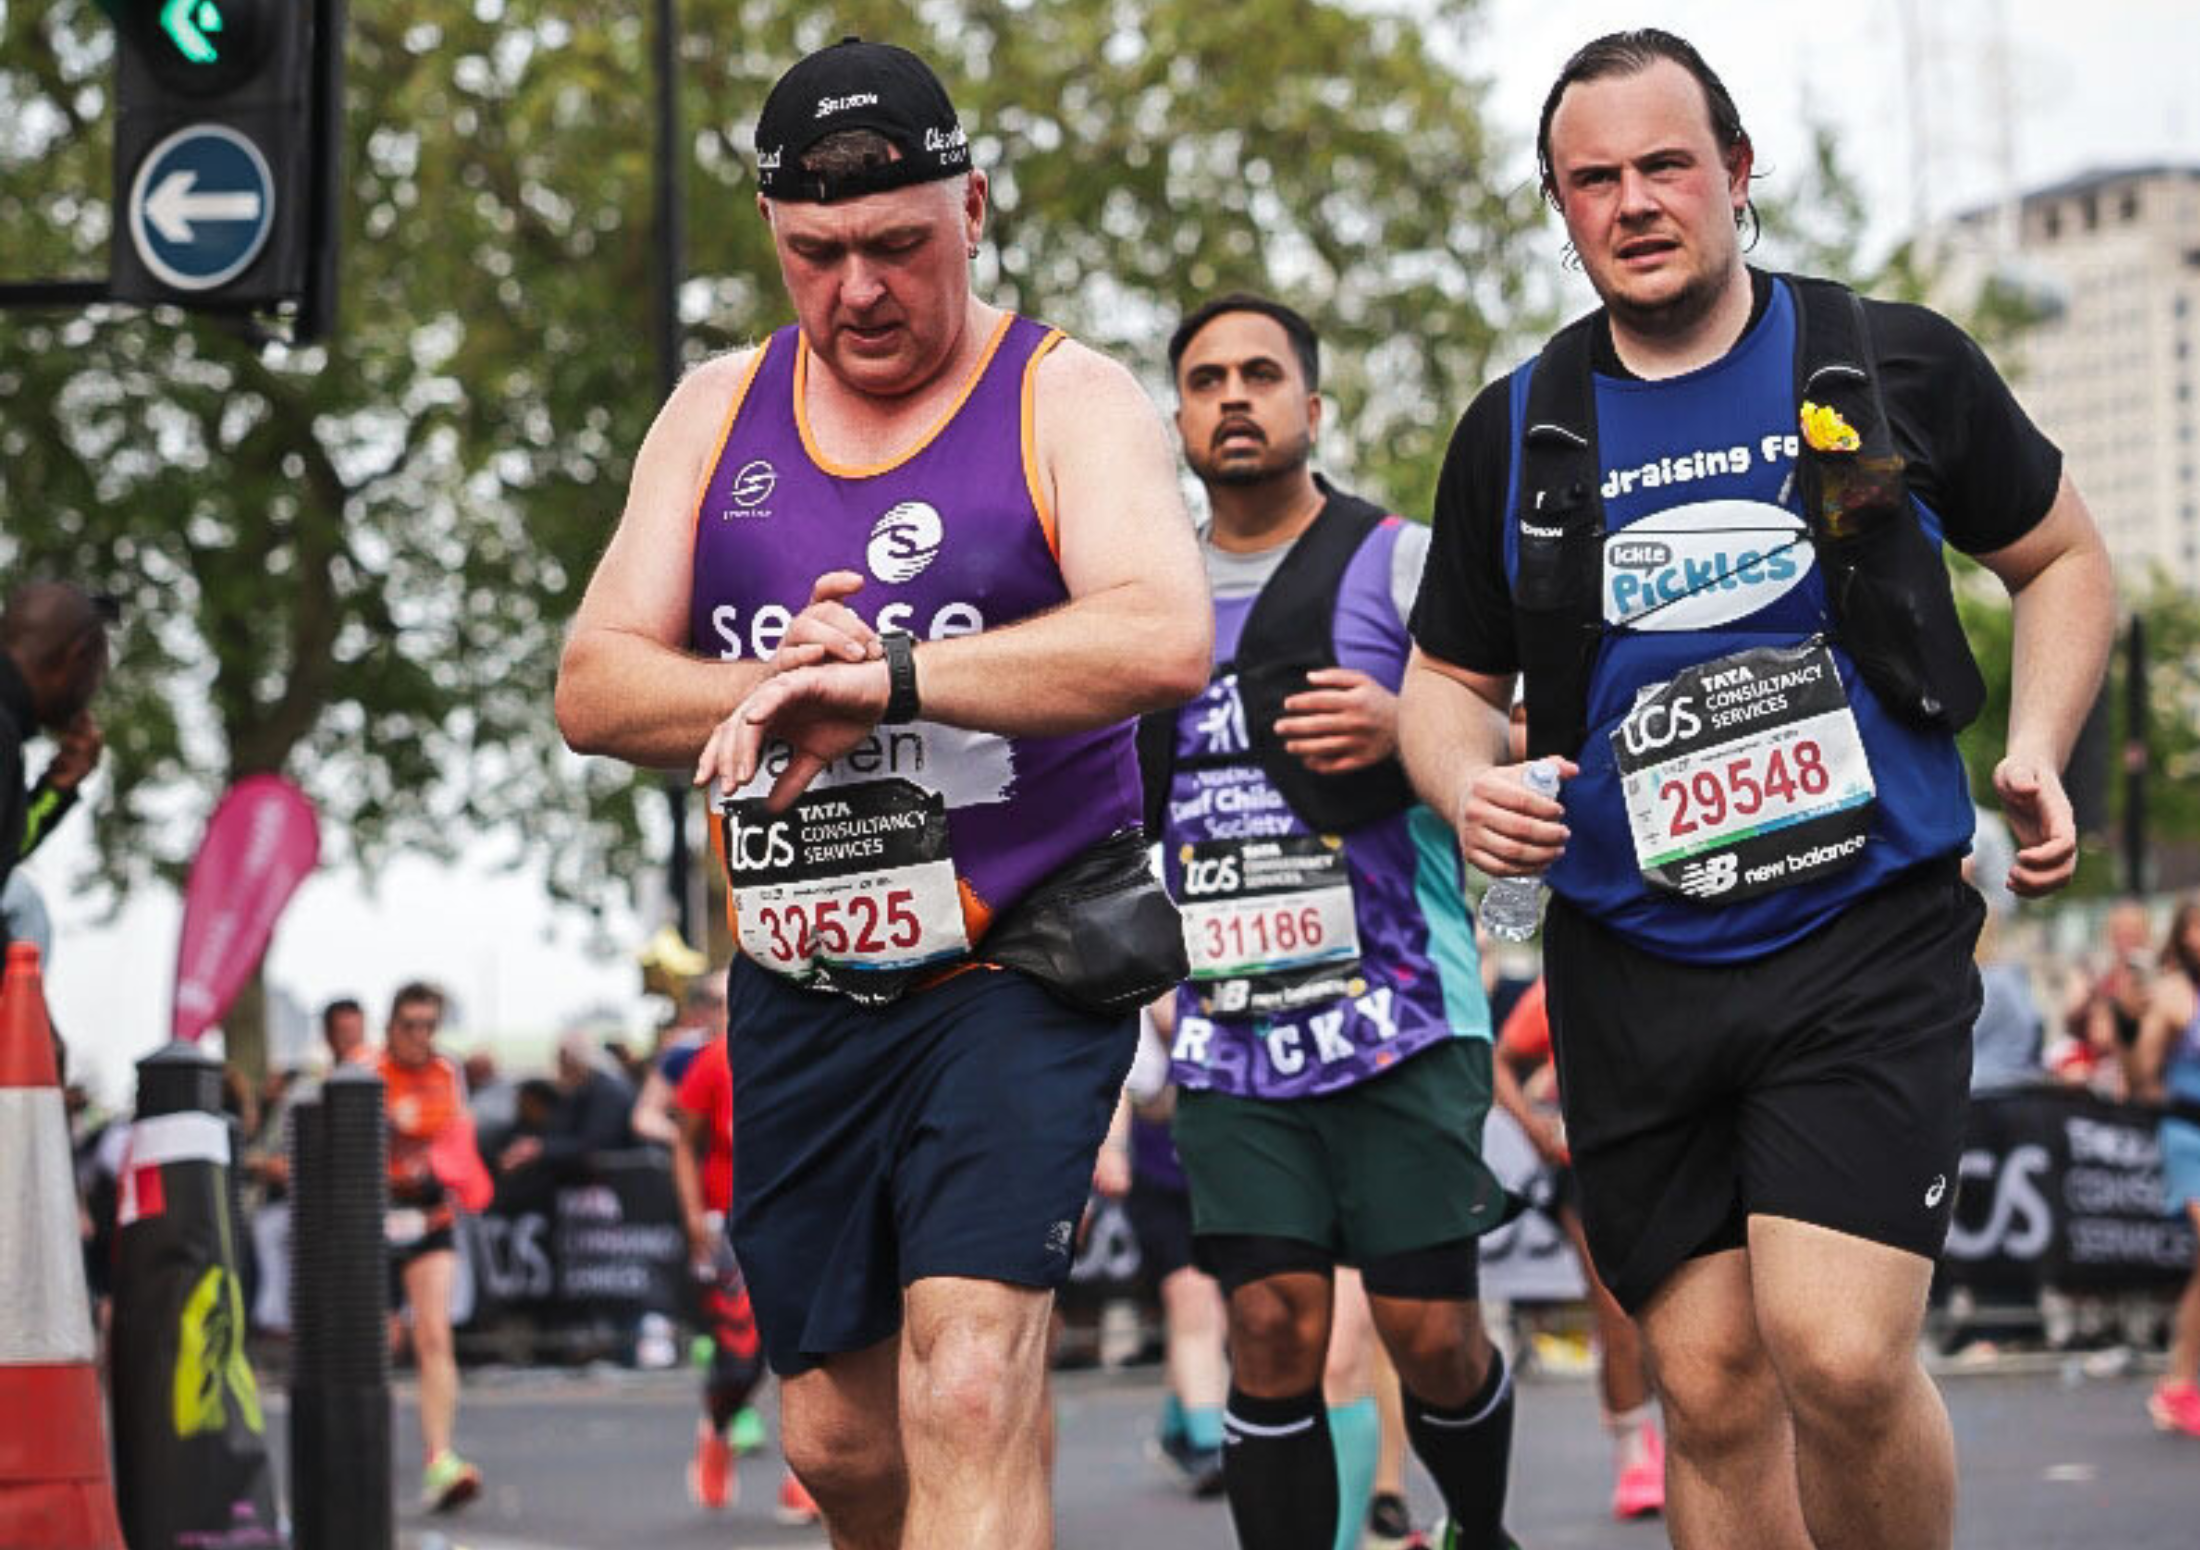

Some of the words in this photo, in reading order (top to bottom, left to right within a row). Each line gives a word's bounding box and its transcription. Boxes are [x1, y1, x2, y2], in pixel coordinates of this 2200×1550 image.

[1611, 545, 1797, 615] Pickles
[712, 602, 984, 661] sese
[1700, 665, 1754, 693] TATA
[1705, 664, 1823, 710] CONSULTANCY
[1711, 694, 1789, 730] SERVICES
[799, 802, 852, 823] TATA
[1660, 740, 1830, 837] 29548
[729, 811, 796, 871] tcs
[801, 810, 927, 843] CONSULTANCY
[803, 838, 884, 865] SERVICES
[1745, 860, 1786, 884] new
[1786, 835, 1866, 872] balance
[758, 889, 922, 962] 32525
[1206, 907, 1324, 960] 31186
[1171, 987, 1399, 1076] RCKY
